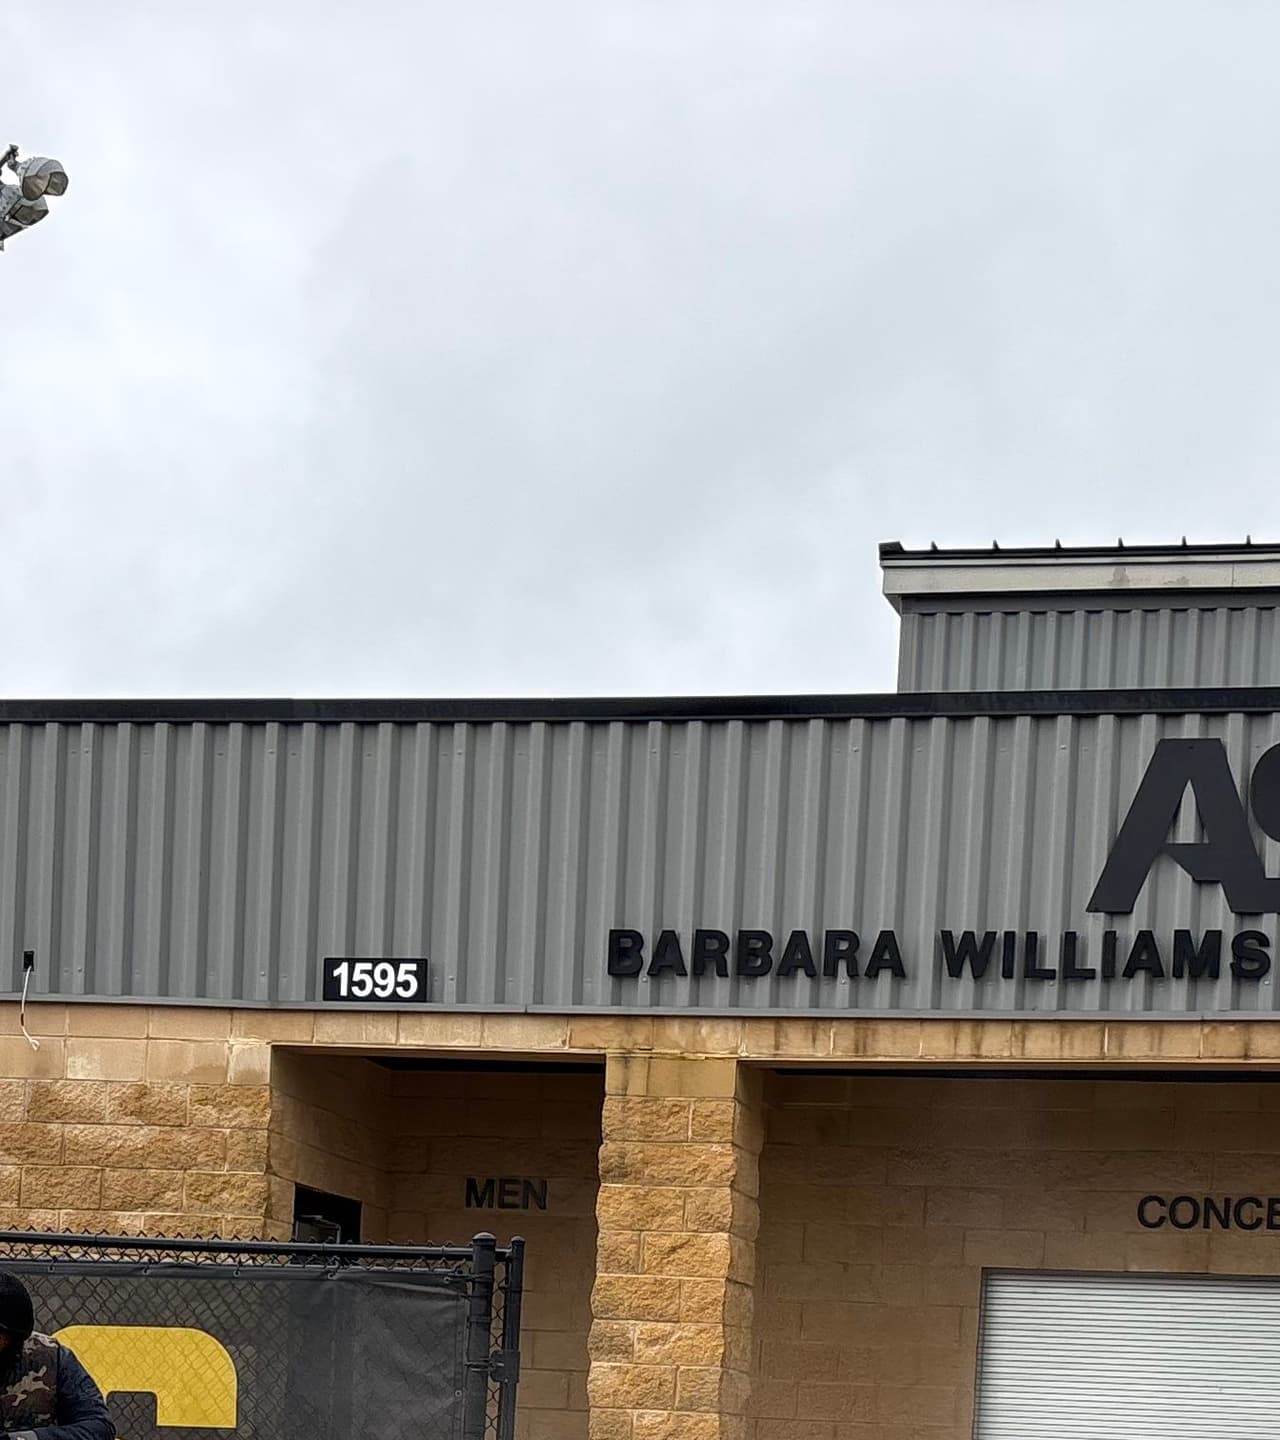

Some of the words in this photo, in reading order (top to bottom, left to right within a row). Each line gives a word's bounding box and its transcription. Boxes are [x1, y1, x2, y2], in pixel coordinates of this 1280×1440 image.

[606, 928, 907, 980] BARBARA
[940, 928, 1272, 982] WILLIAMS
[332, 962, 418, 998] 1595
[464, 1176, 548, 1211] MEN
